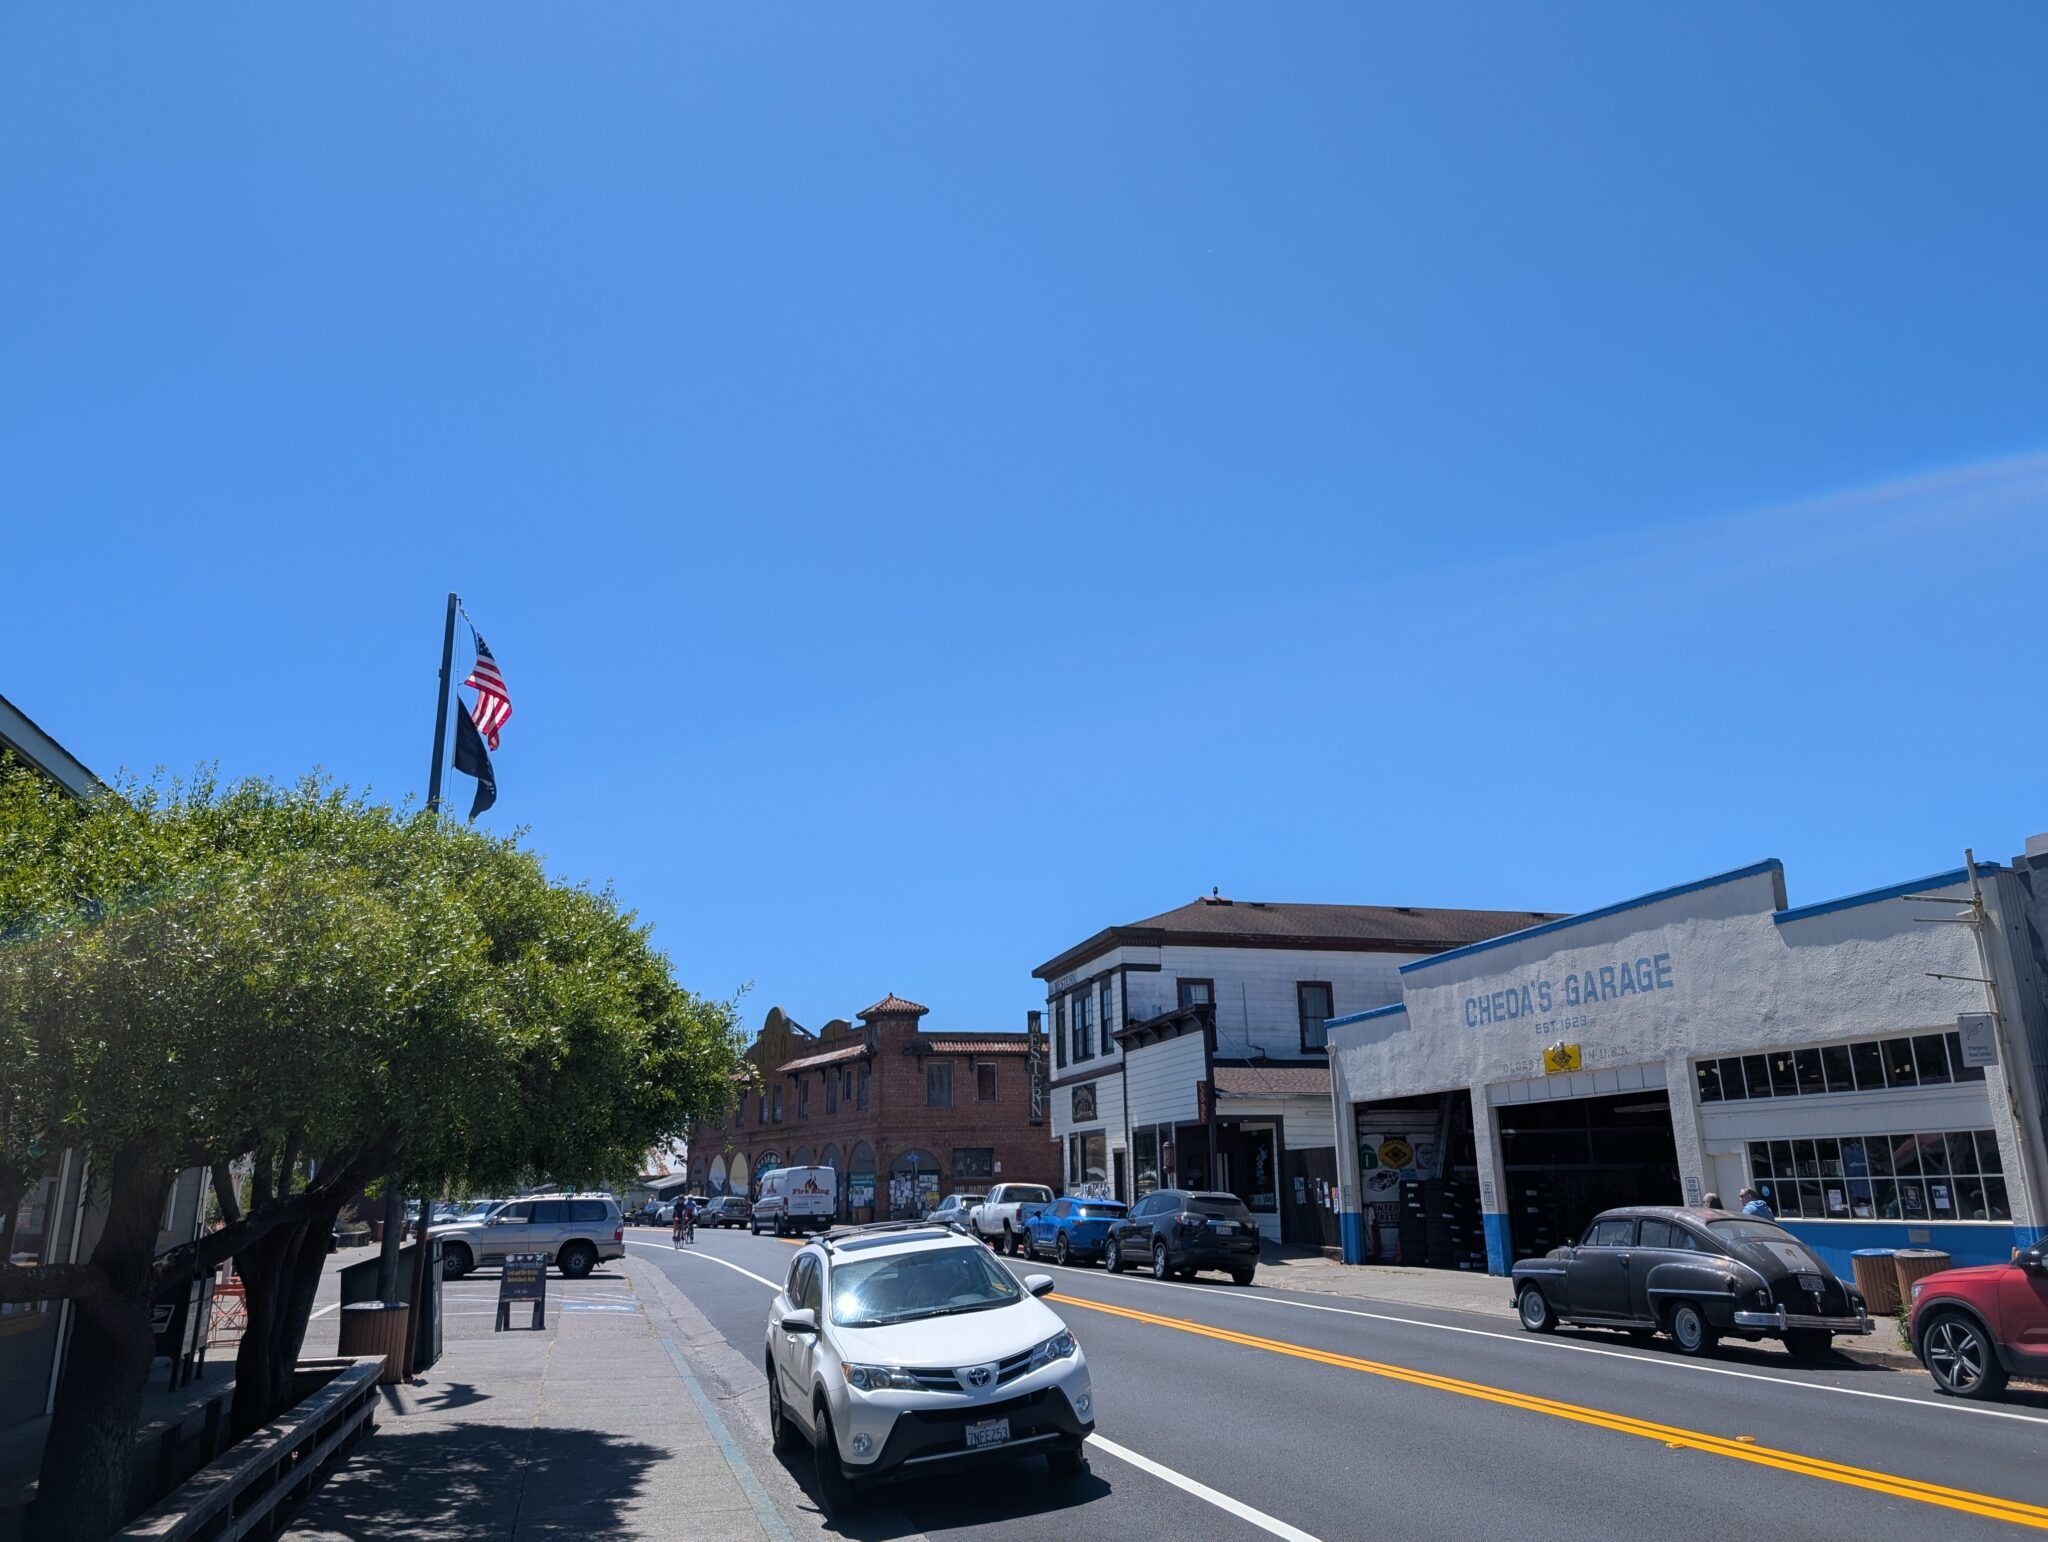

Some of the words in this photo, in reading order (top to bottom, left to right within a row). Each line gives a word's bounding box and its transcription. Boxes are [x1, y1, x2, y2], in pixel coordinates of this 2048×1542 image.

[1464, 980, 1551, 1028] CHEDA'S
[1564, 953, 1674, 1006] GARAGE
[1029, 1018, 1042, 1118] WESTERN
